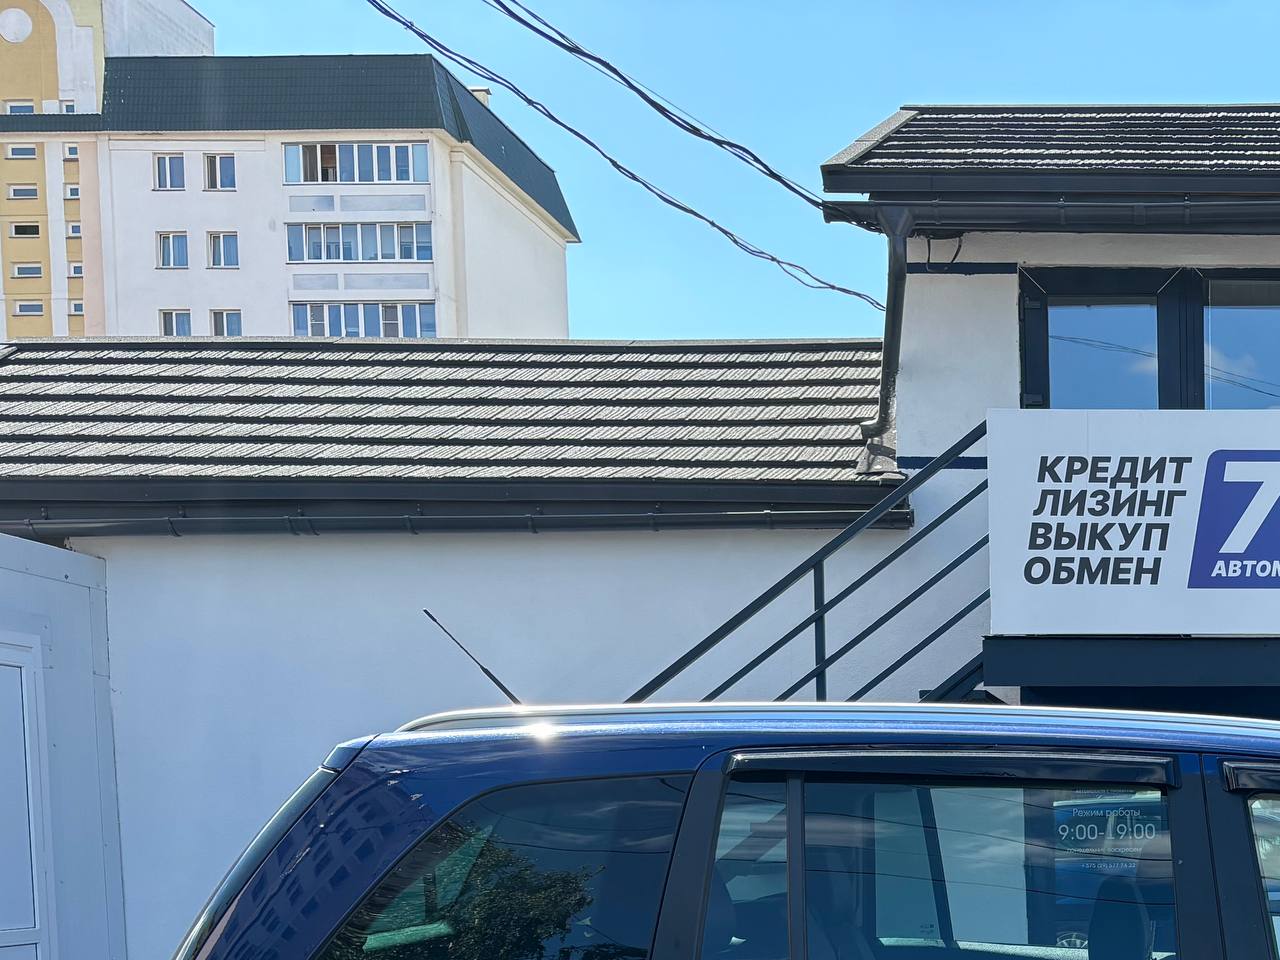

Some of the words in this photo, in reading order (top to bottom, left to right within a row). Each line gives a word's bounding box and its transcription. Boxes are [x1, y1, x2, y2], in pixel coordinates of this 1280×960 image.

[1036, 455, 1193, 487] КРЕДИТ
[1032, 489, 1187, 518] ЛИЗИНГ
[1027, 522, 1170, 551] ВЫКУП
[1023, 556, 1162, 585] ОБМЕН
[1072, 808, 1104, 817] Режим
[1105, 807, 1141, 818] работы
[1058, 823, 1156, 840] 9:00-19:00
